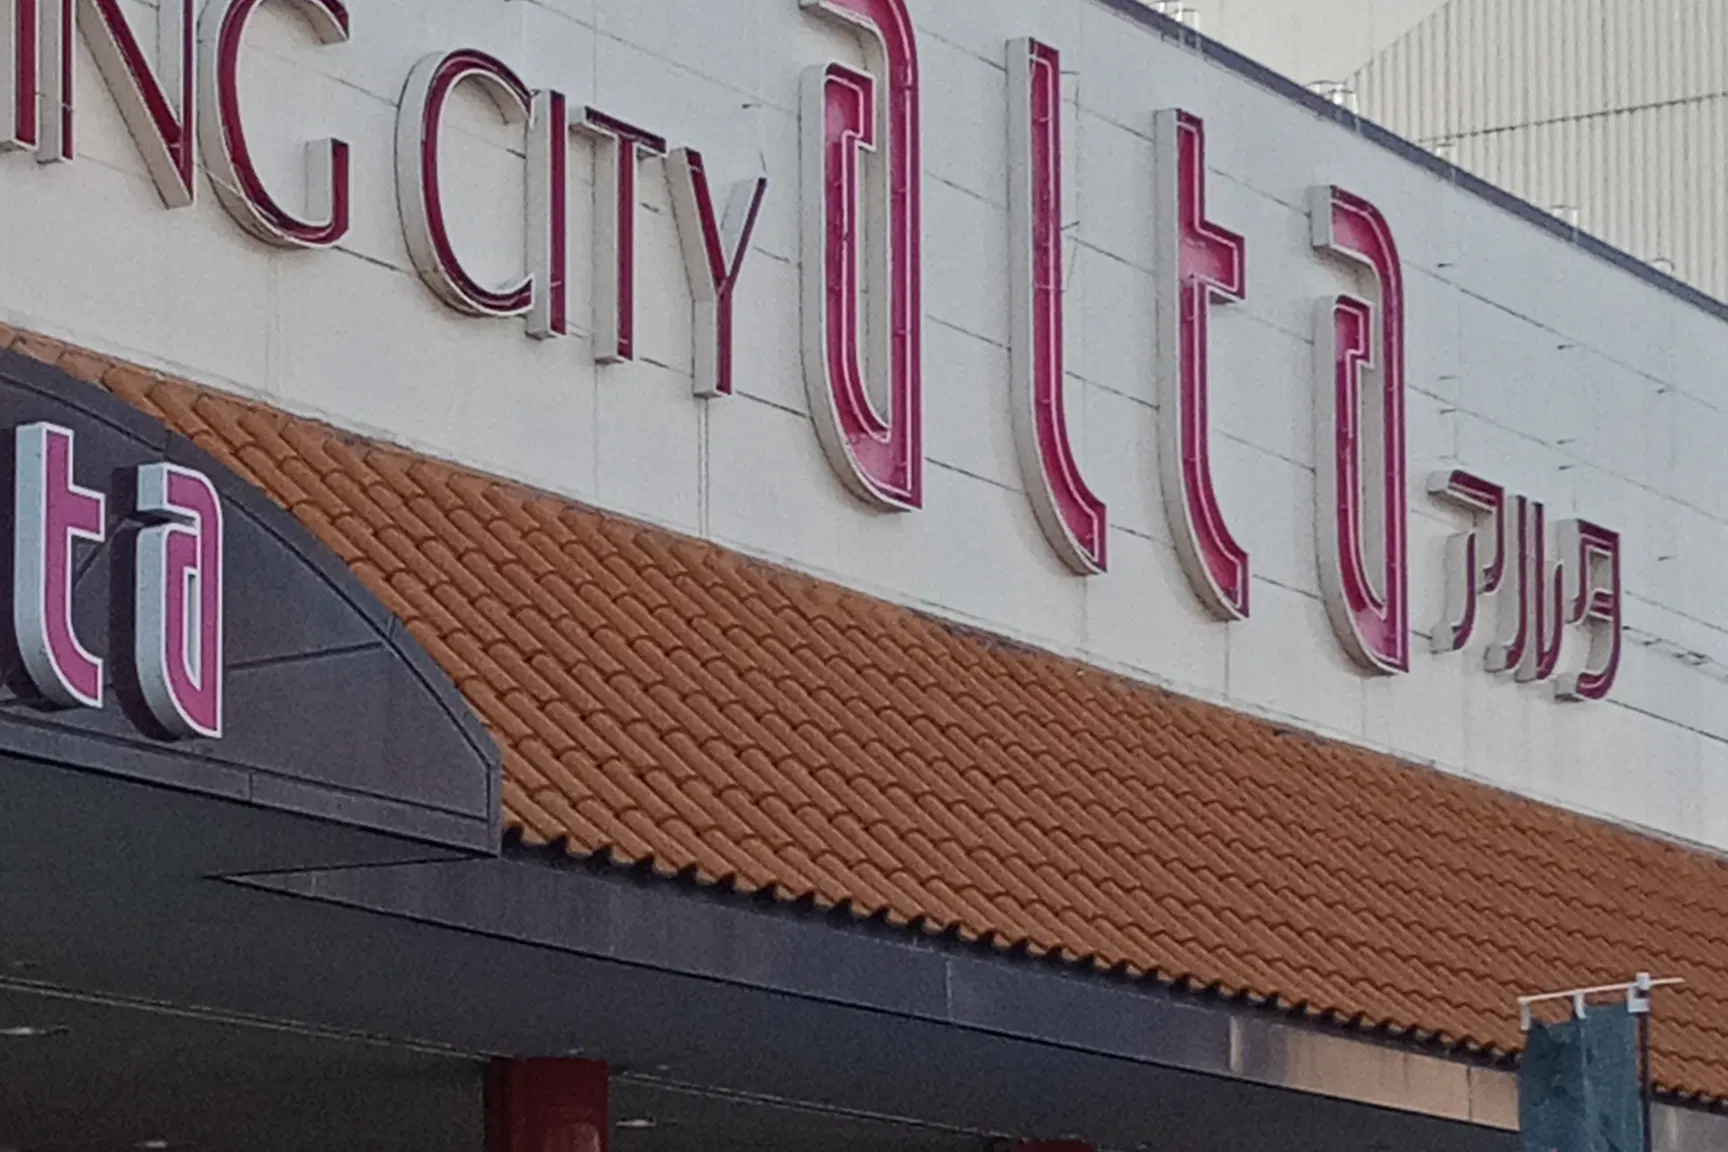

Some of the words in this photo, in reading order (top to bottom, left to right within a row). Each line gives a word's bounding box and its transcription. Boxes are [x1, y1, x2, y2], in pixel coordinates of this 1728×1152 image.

[395, 48, 768, 398] CITY
[1428, 468, 1623, 702] アルタ
